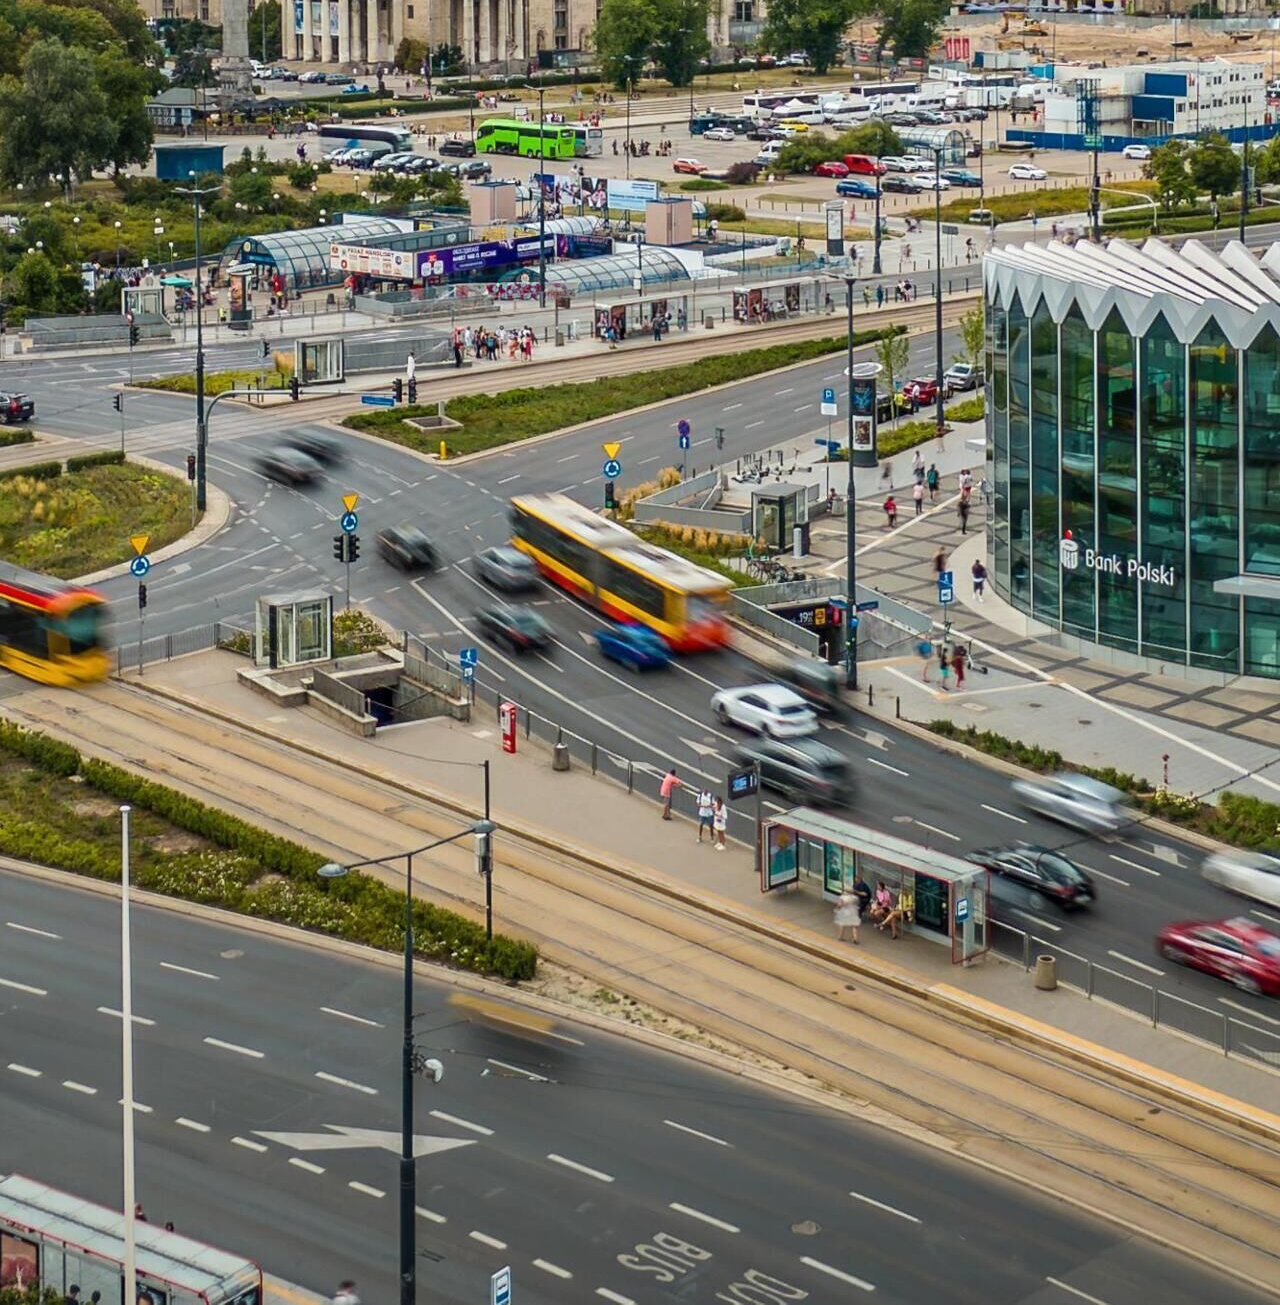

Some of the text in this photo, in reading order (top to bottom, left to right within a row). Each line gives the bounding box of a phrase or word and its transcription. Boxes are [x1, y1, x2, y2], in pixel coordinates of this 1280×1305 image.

[1085, 548, 1122, 575] Bank
[1127, 559, 1174, 586] Polski
[616, 1232, 713, 1283] BUS
